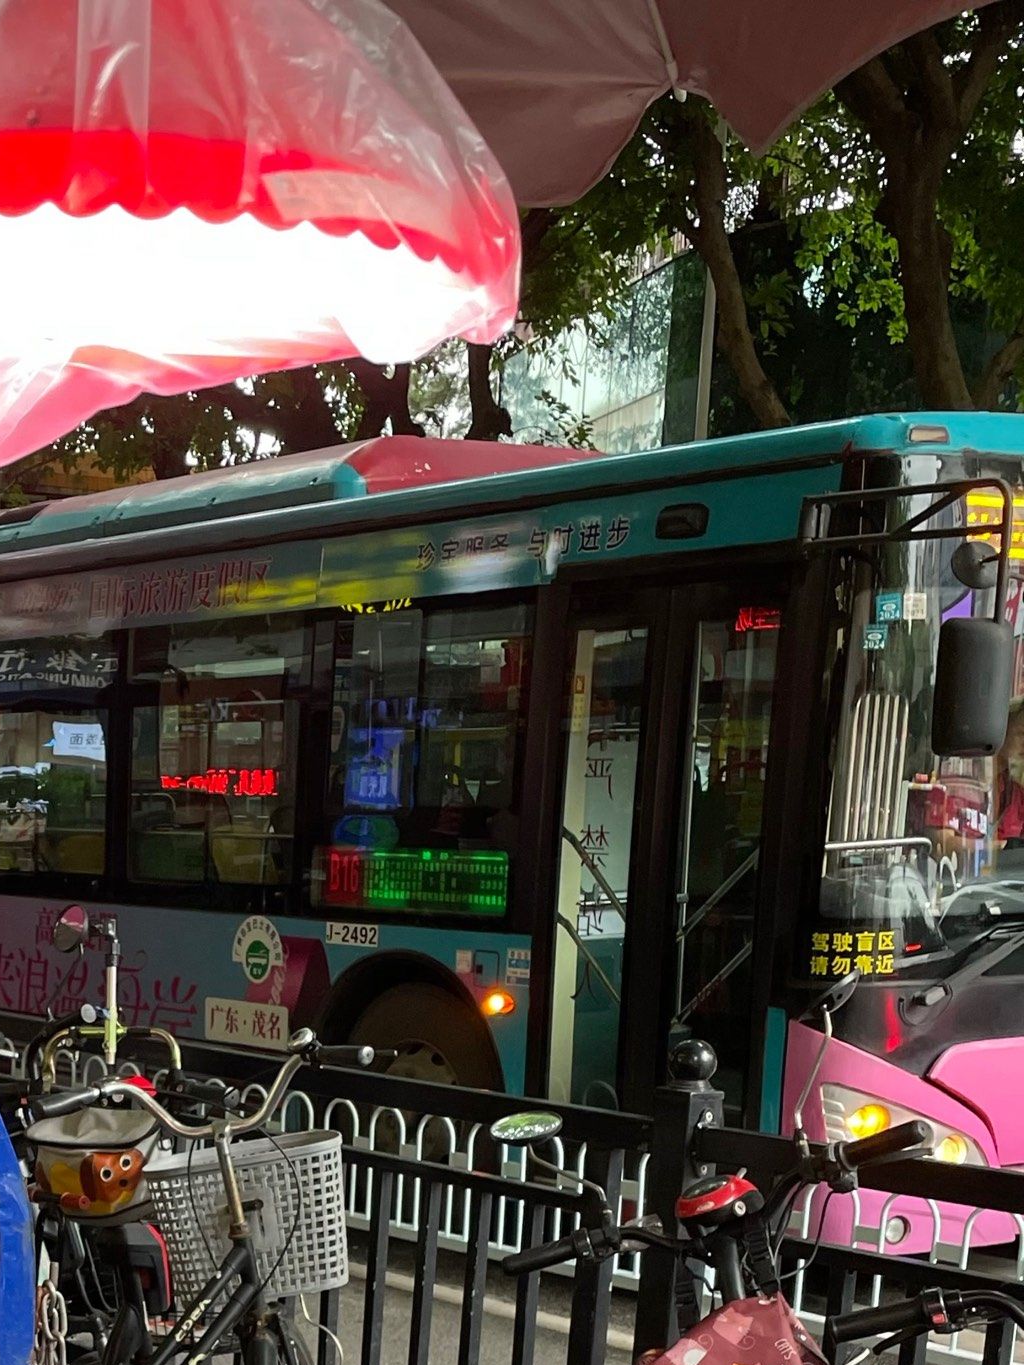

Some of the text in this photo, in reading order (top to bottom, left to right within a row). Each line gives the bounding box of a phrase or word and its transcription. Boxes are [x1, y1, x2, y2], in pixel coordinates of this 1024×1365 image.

[327, 924, 377, 946] J-2492
[811, 931, 895, 952] 驾驶盲区
[810, 954, 894, 975] 请勿靠近
[775, 1338, 797, 1361] CATS
